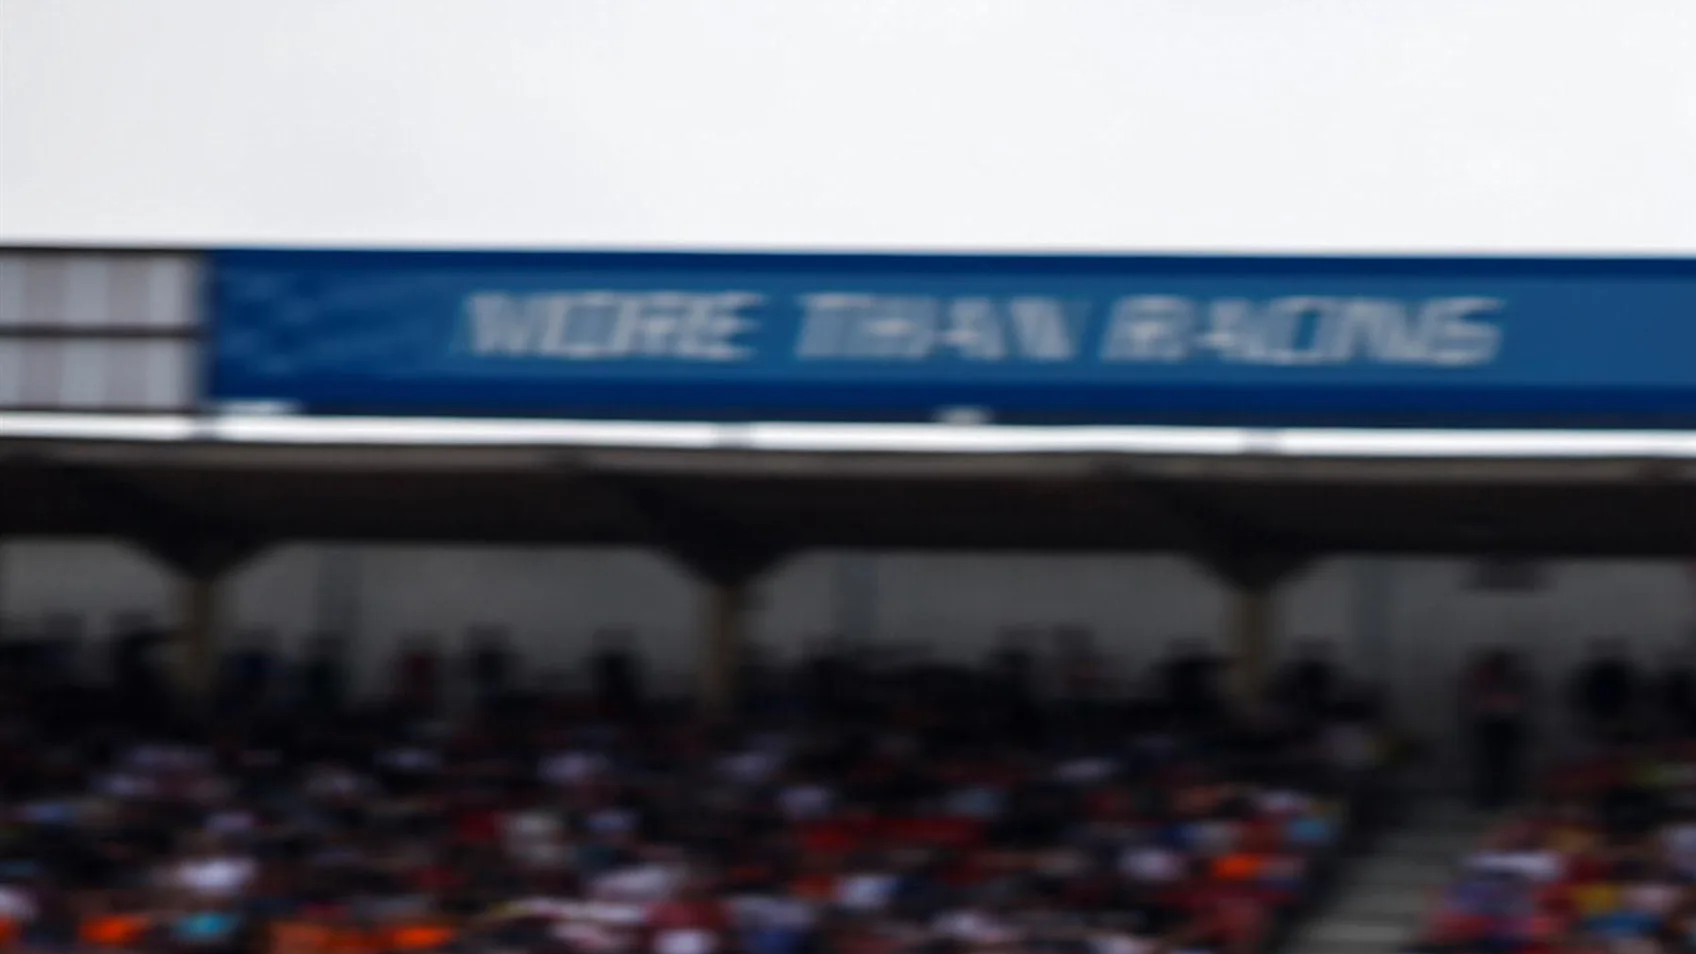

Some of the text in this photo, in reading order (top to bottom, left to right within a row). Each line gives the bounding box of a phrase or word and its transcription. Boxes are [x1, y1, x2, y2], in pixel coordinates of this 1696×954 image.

[464, 292, 1506, 367] MORE THAN RACING
